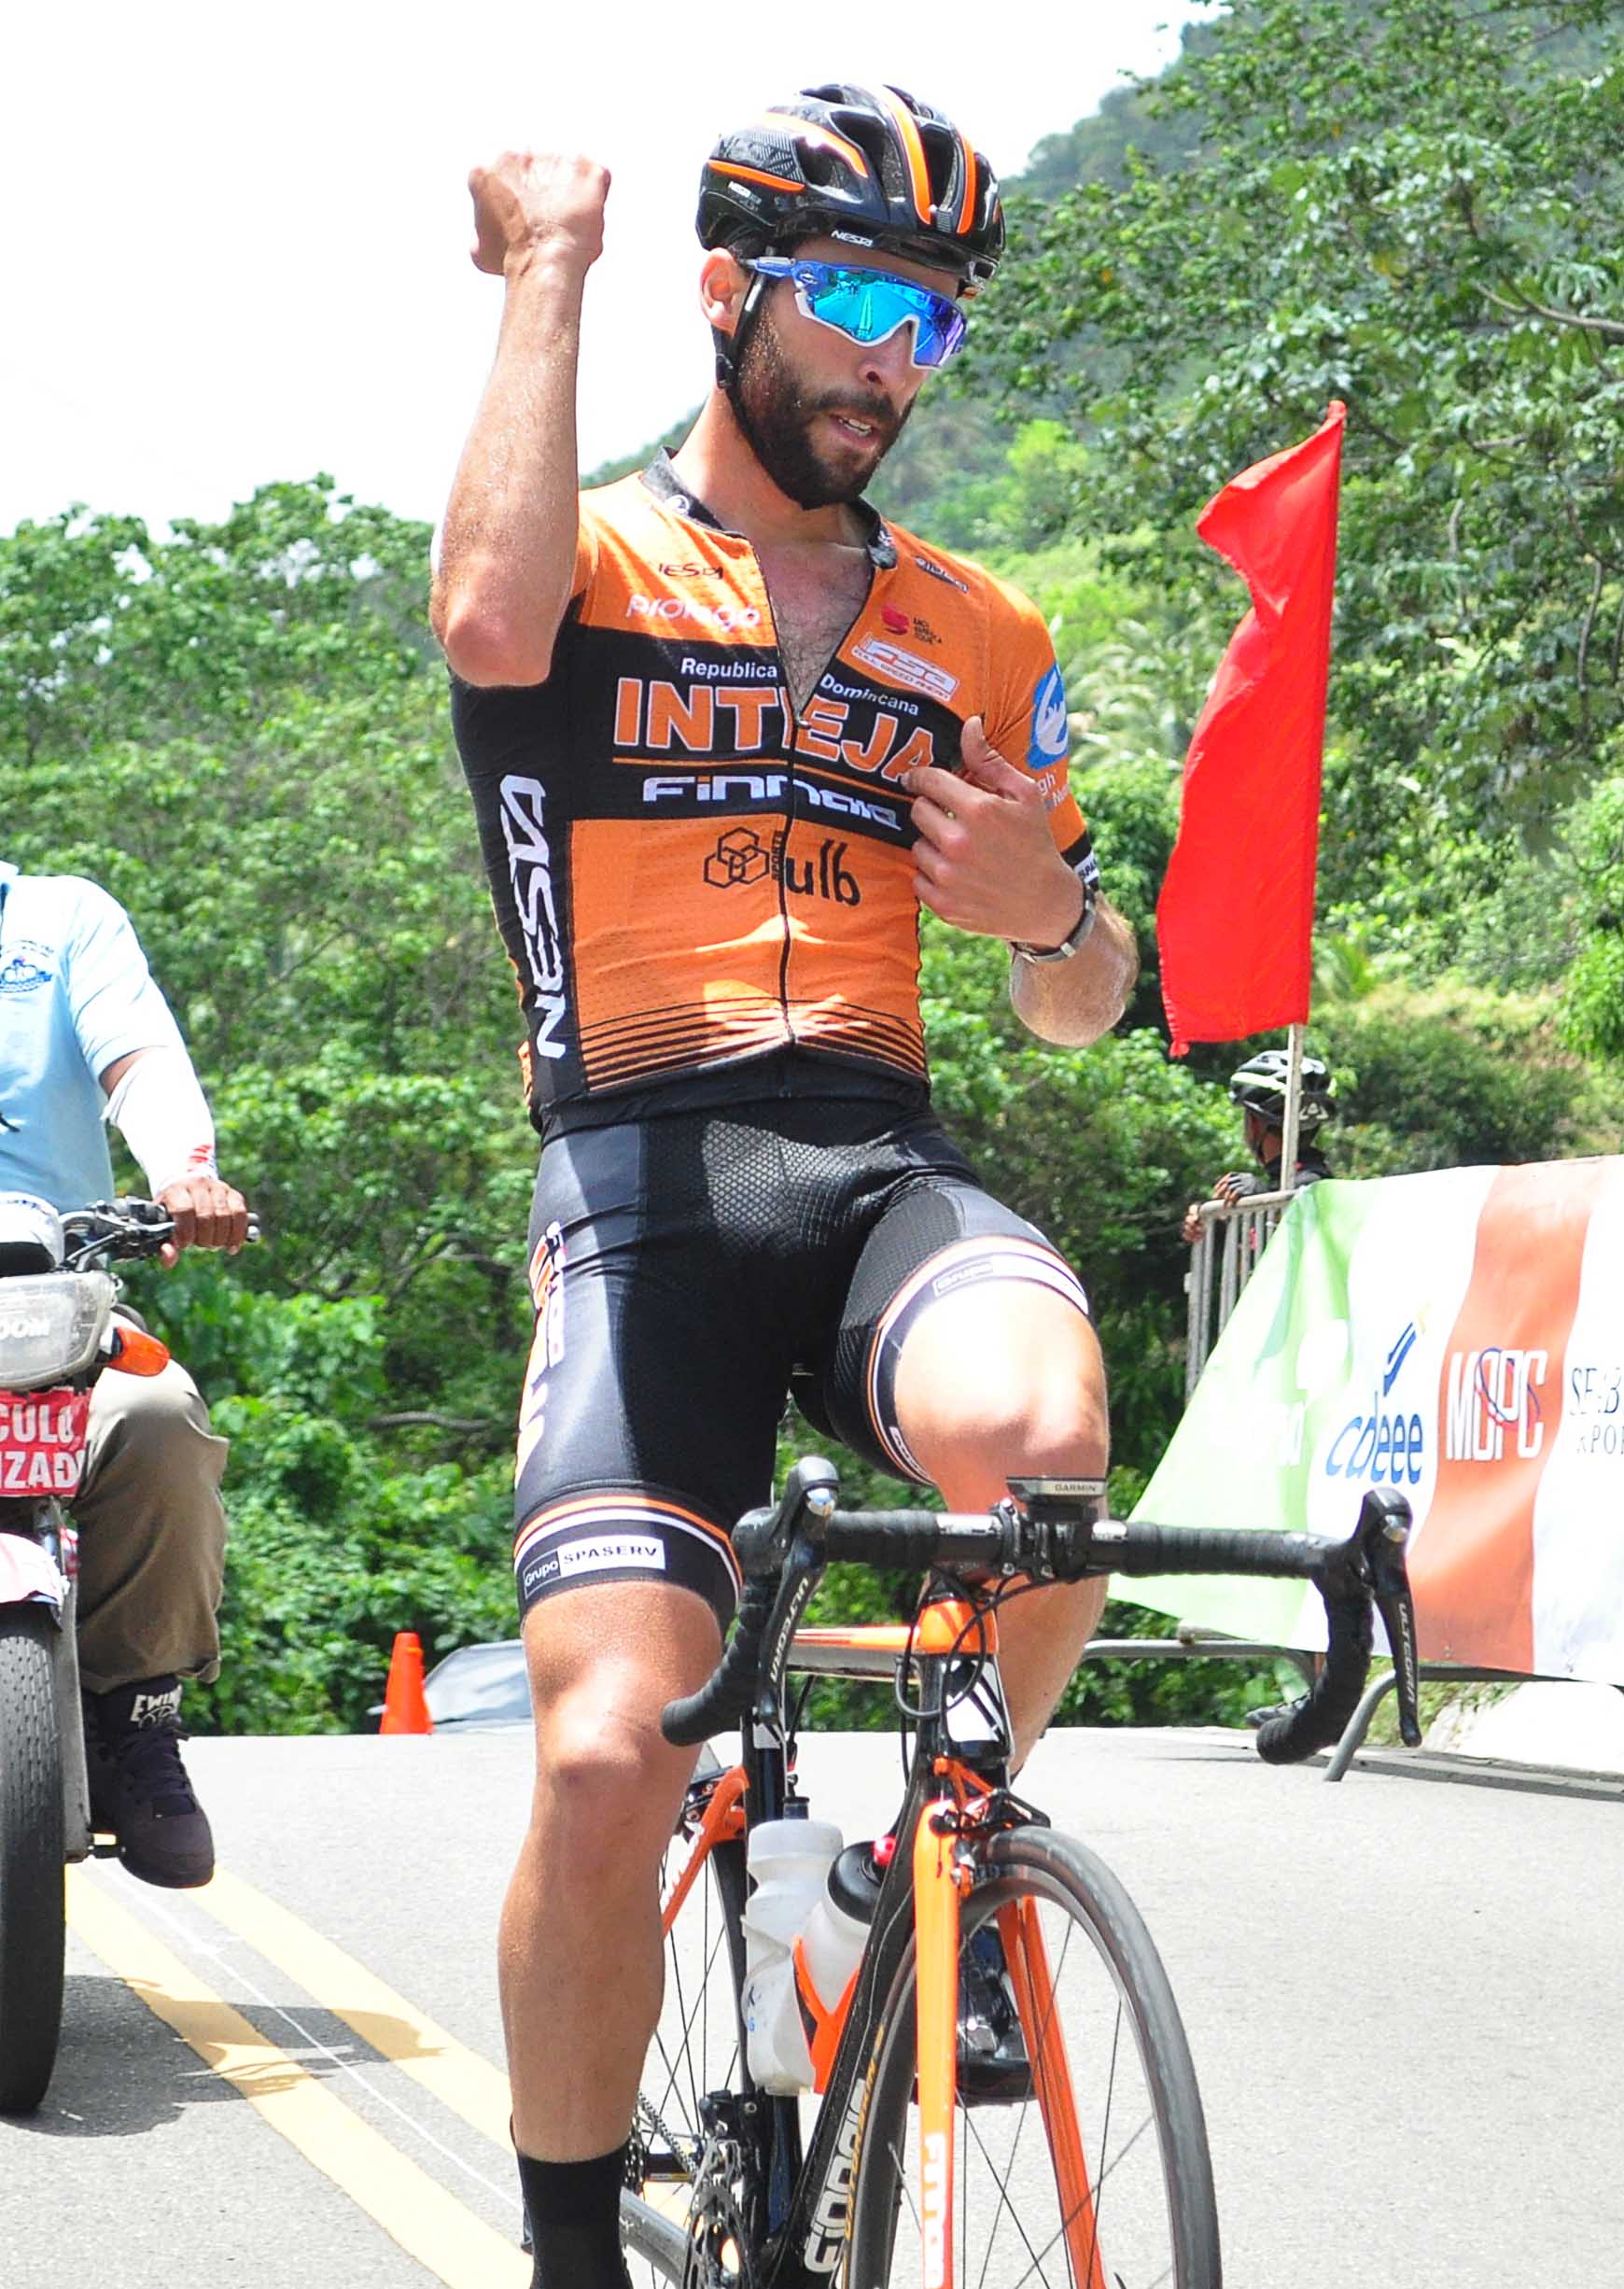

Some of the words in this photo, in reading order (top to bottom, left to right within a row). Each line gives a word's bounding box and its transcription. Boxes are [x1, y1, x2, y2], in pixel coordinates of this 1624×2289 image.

[681, 657, 777, 680] Republica
[614, 676, 933, 782] INTEJA
[0, 1449, 86, 1490] ZAD
[525, 1560, 559, 1586] Grupo
[563, 1545, 658, 1566] SPASERV
